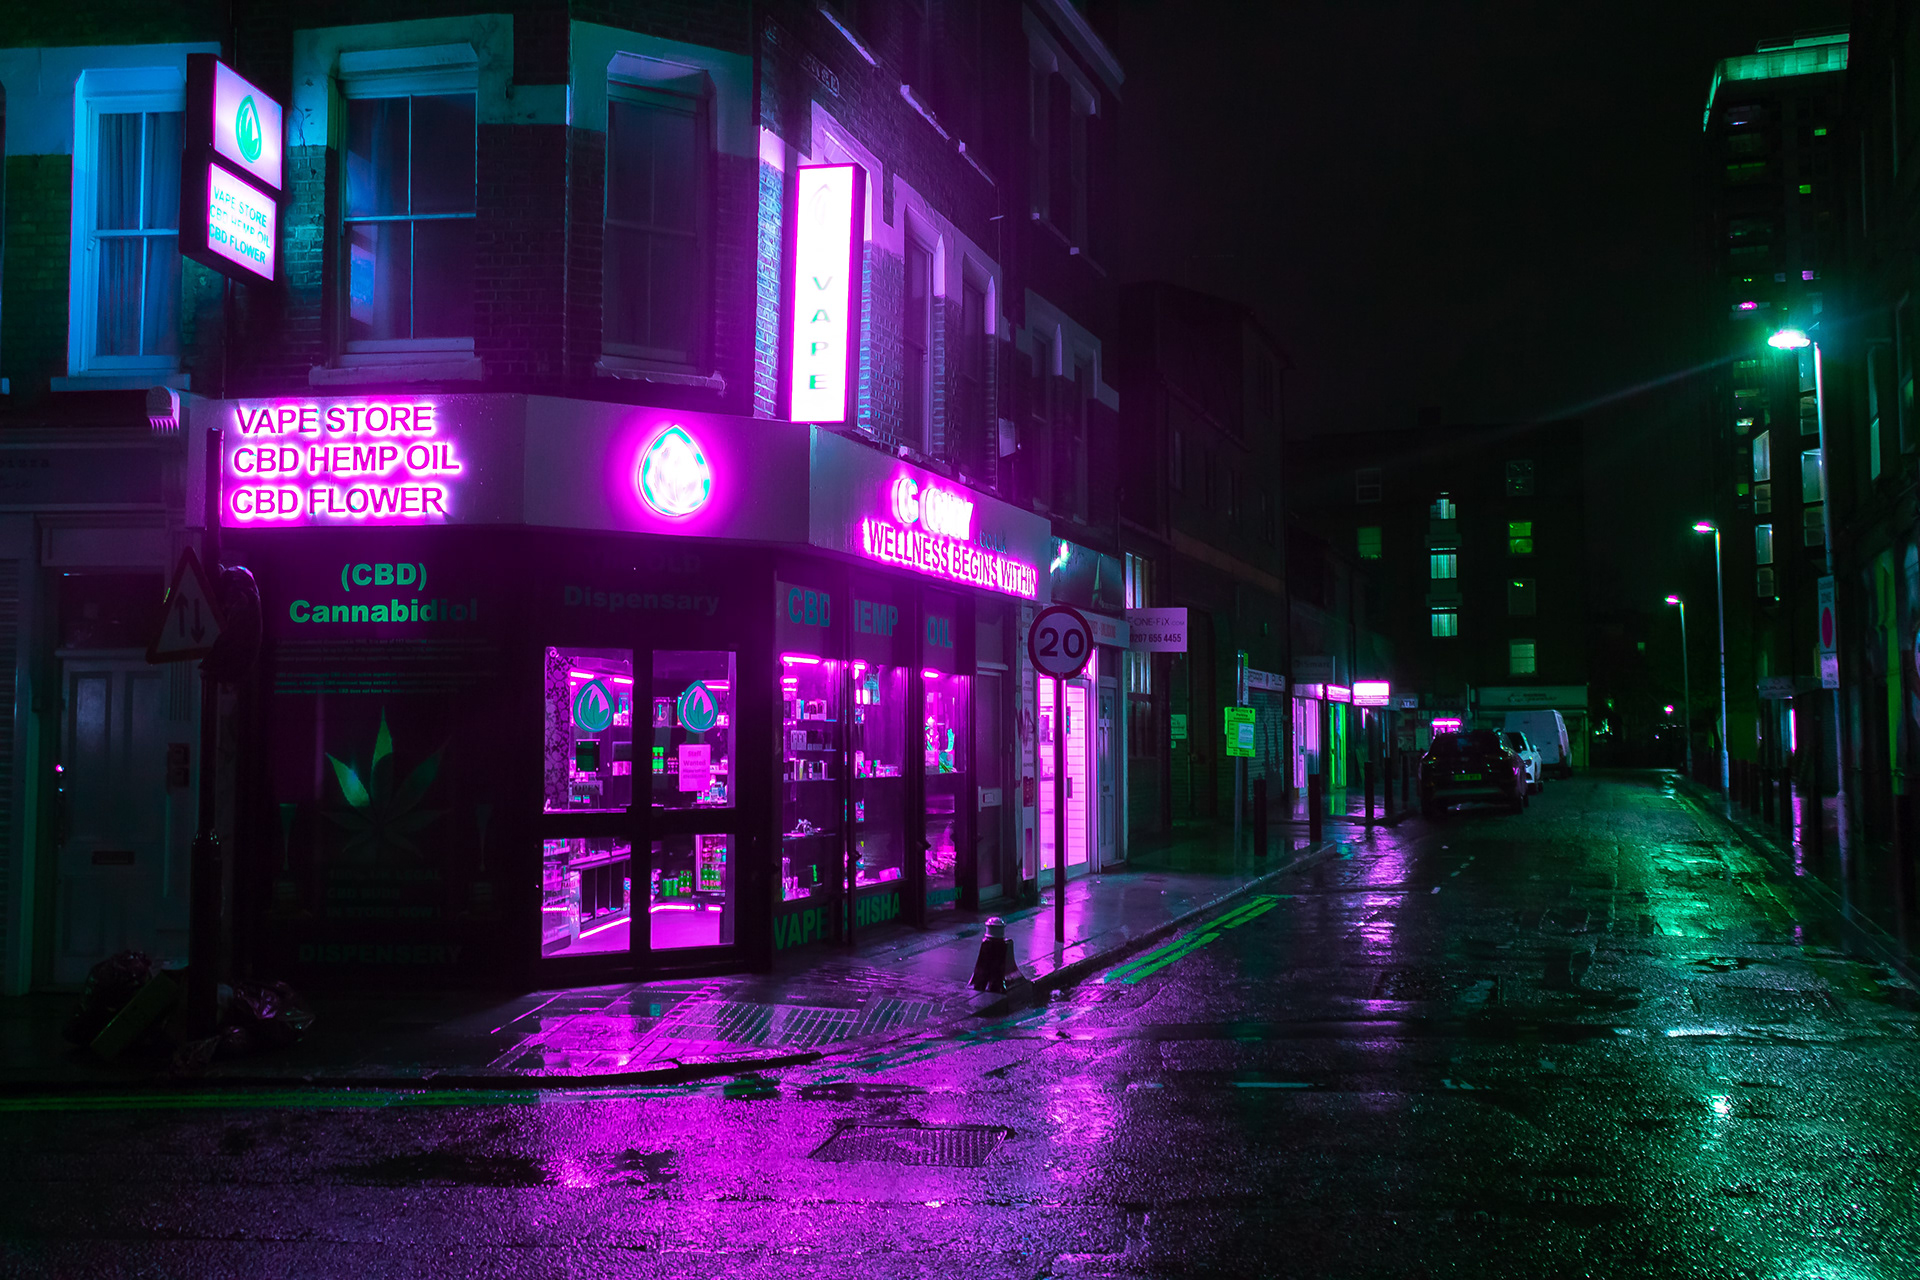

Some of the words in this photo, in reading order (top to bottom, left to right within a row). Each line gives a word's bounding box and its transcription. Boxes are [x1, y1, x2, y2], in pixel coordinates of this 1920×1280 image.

[214, 185, 236, 210] VAPE
[238, 201, 267, 228] STORE
[209, 204, 228, 225] CBD
[257, 230, 271, 249] OIL
[209, 223, 228, 244] CBD
[229, 234, 266, 265] FLOWER
[808, 276, 833, 390] VAPE
[235, 407, 318, 435] VAPE
[326, 406, 433, 433] STORE
[233, 446, 299, 474] CBD
[309, 445, 399, 473] HEMP
[404, 444, 460, 471] OIL
[232, 487, 298, 514] CBD
[309, 486, 444, 514] FLOWER
[868, 521, 949, 572] WELLNESS
[952, 545, 998, 584] BEGINS
[1000, 558, 1038, 597] WITHIN
[340, 562, 428, 592] (CBD)
[288, 598, 479, 625] Cannabidiol
[563, 584, 720, 616] Dispensary
[788, 587, 831, 627] CBD
[927, 616, 953, 648] OIL
[1038, 626, 1085, 658] 20
[1148, 633, 1162, 643] 655
[1163, 633, 1182, 643] 4455
[773, 905, 829, 951] VAPE
